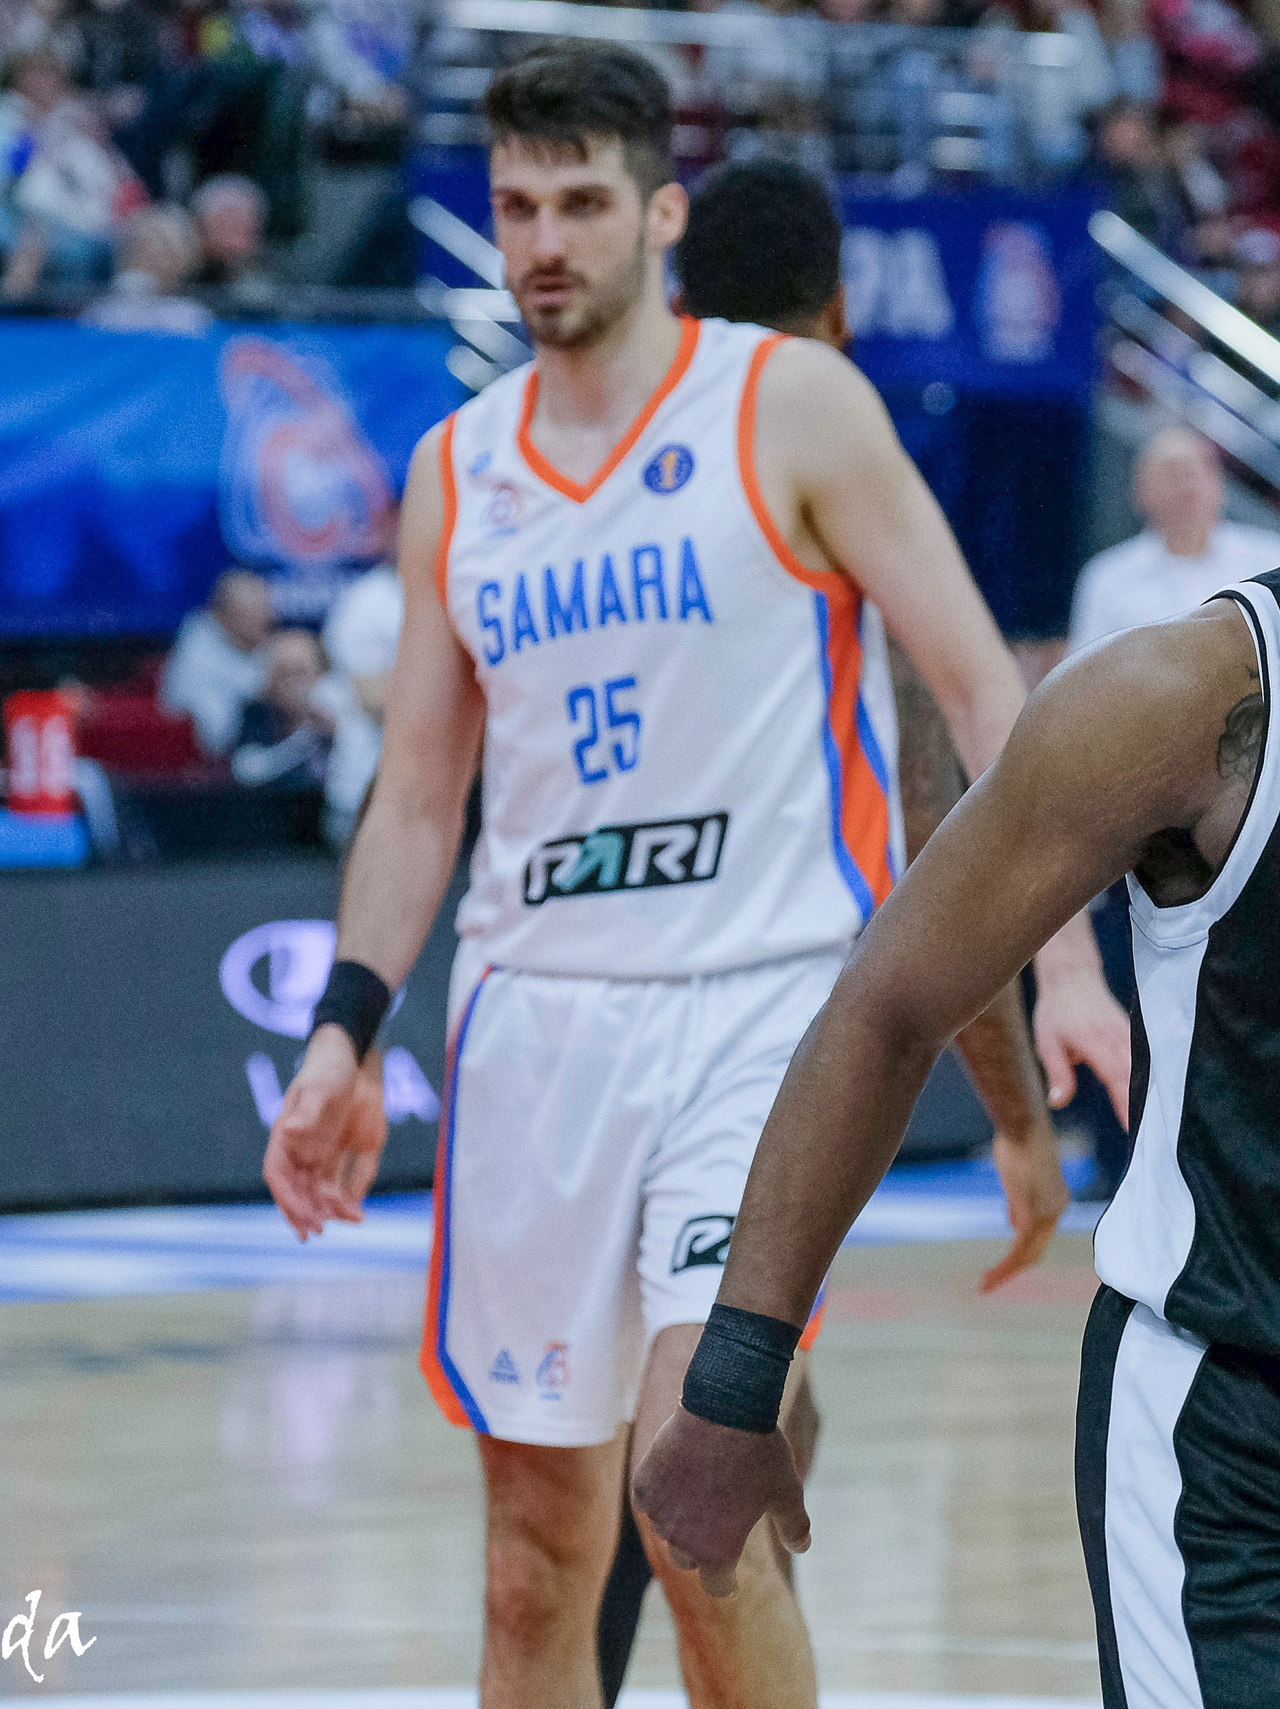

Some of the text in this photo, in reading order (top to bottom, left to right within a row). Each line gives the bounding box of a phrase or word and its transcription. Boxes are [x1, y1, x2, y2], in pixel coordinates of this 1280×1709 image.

[476, 536, 714, 668] SAMARA
[566, 676, 641, 785] 25
[525, 814, 727, 904] PARI
